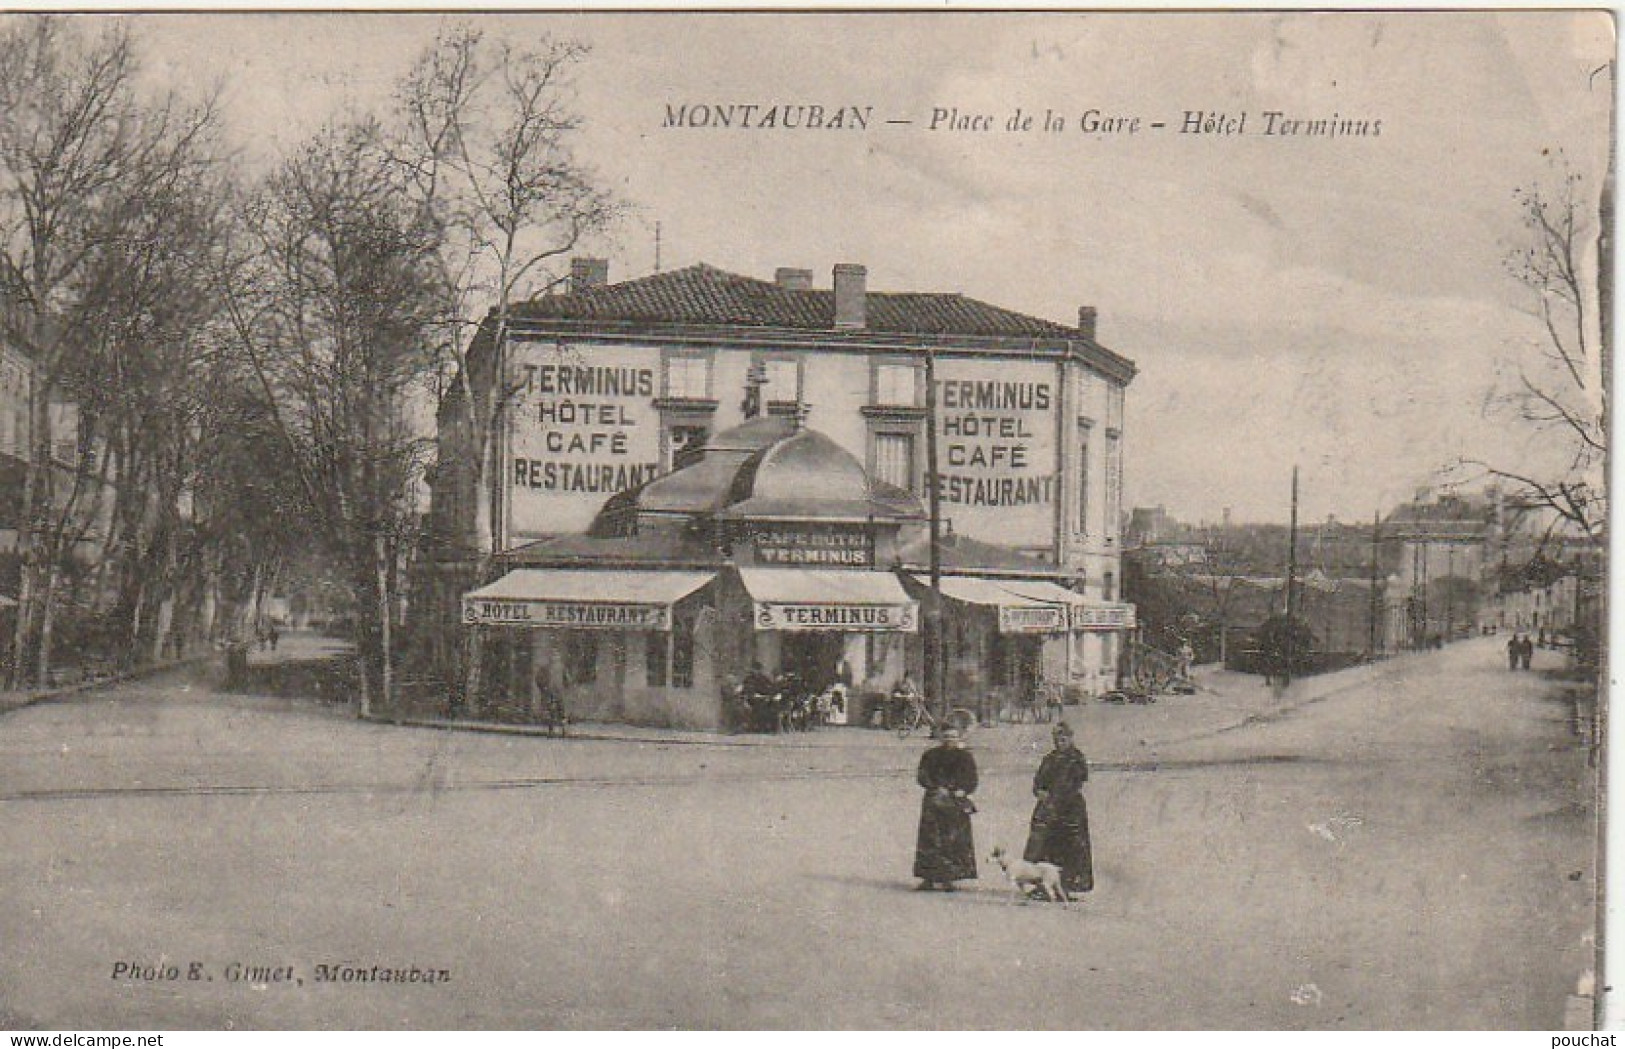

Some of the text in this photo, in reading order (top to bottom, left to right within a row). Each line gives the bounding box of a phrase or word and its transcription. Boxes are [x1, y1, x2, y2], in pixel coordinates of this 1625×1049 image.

[523, 365, 653, 396] TERMINUS
[538, 399, 636, 426] HÔTEL
[944, 412, 1034, 438] HÔTEL
[546, 431, 628, 454] CAFÉ
[949, 443, 1029, 468] CAFÉ
[515, 458, 659, 493] RESTAURANT
[761, 548, 866, 564] TERMINUS
[546, 604, 649, 623] RESTAURANT
[783, 608, 889, 624] TERMINUS
